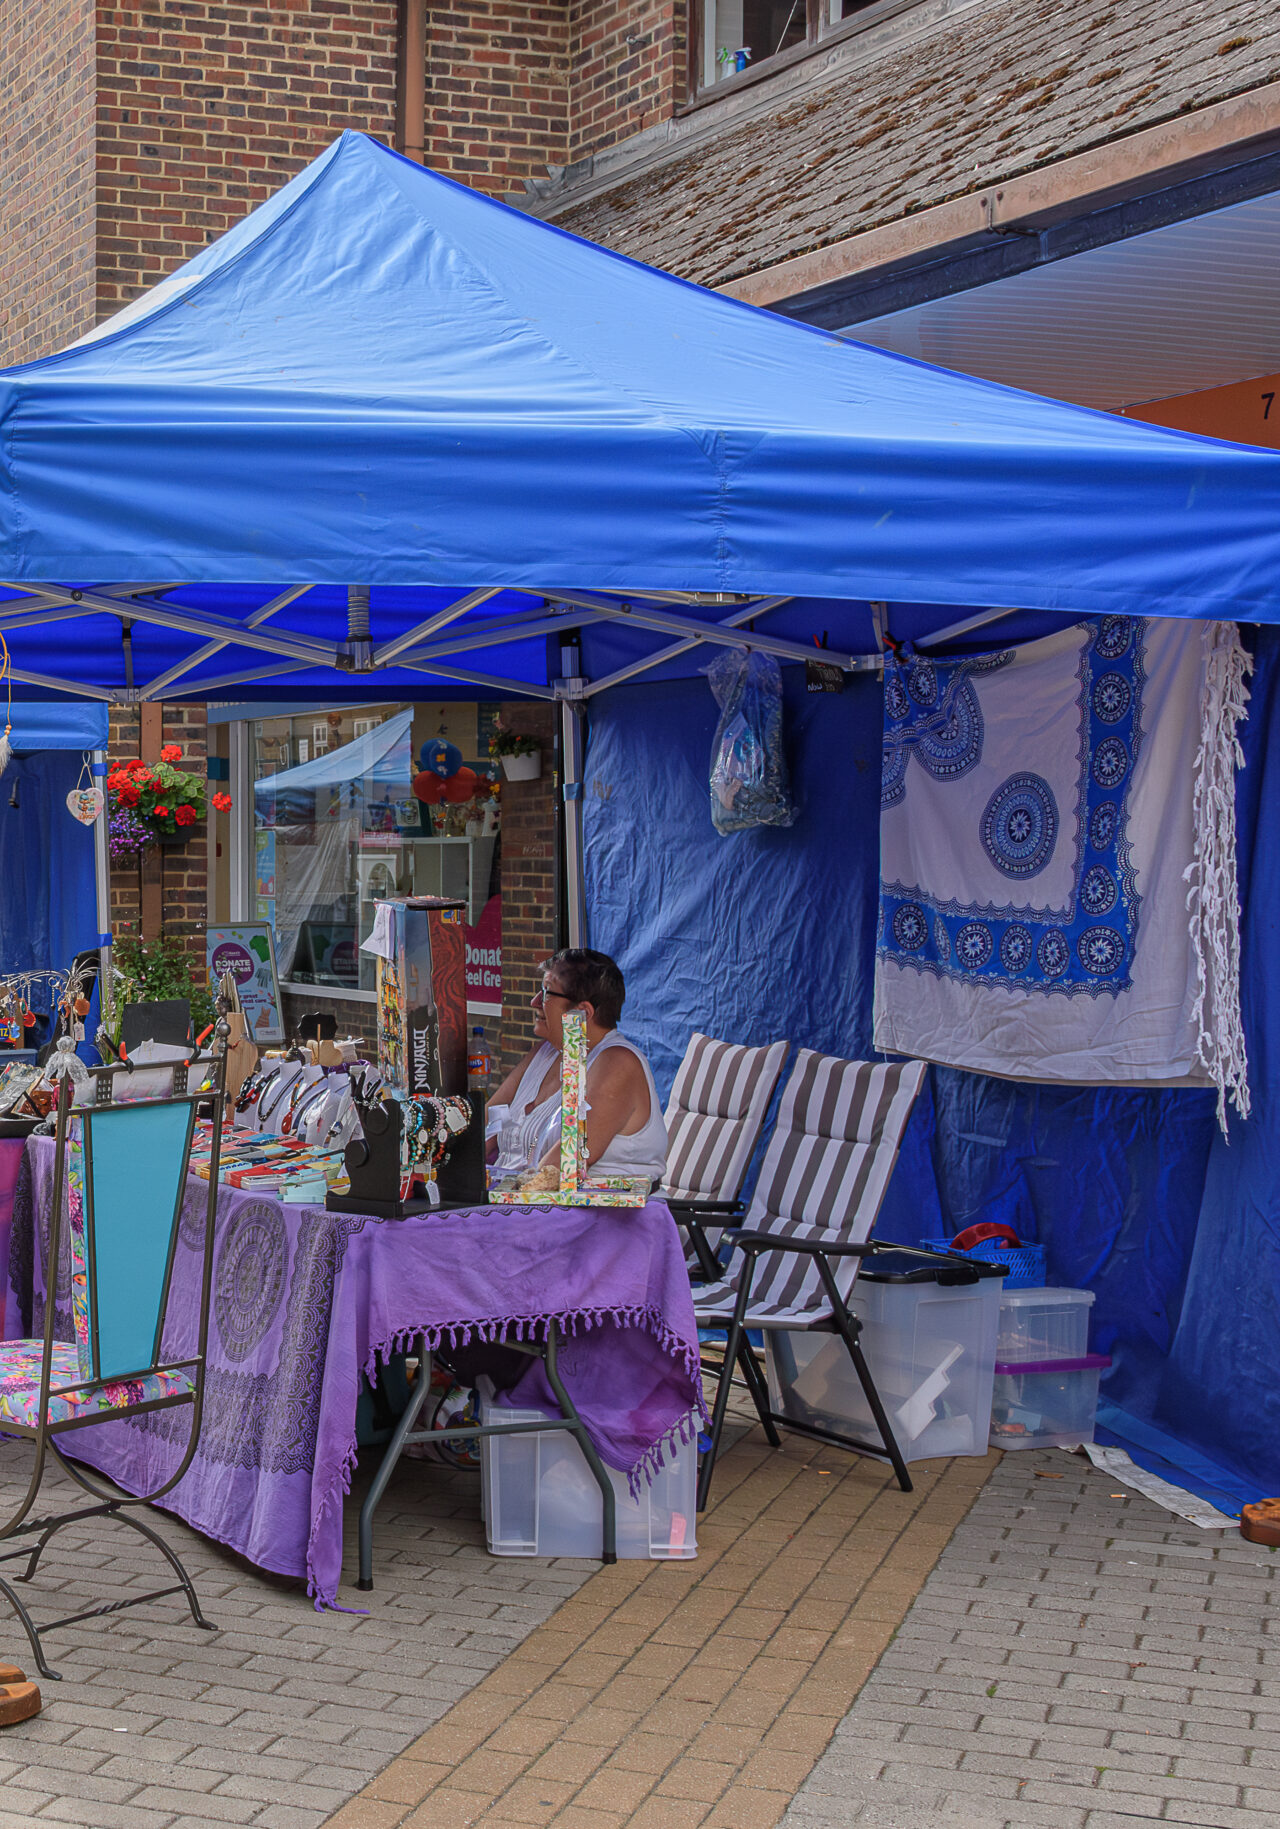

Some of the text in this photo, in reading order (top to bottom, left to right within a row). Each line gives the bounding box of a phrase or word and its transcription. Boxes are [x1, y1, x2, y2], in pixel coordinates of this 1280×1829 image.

[1261, 392, 1276, 420] 7
[215, 959, 251, 967] DONATE
[413, 1025, 431, 1091] NINJAGO
